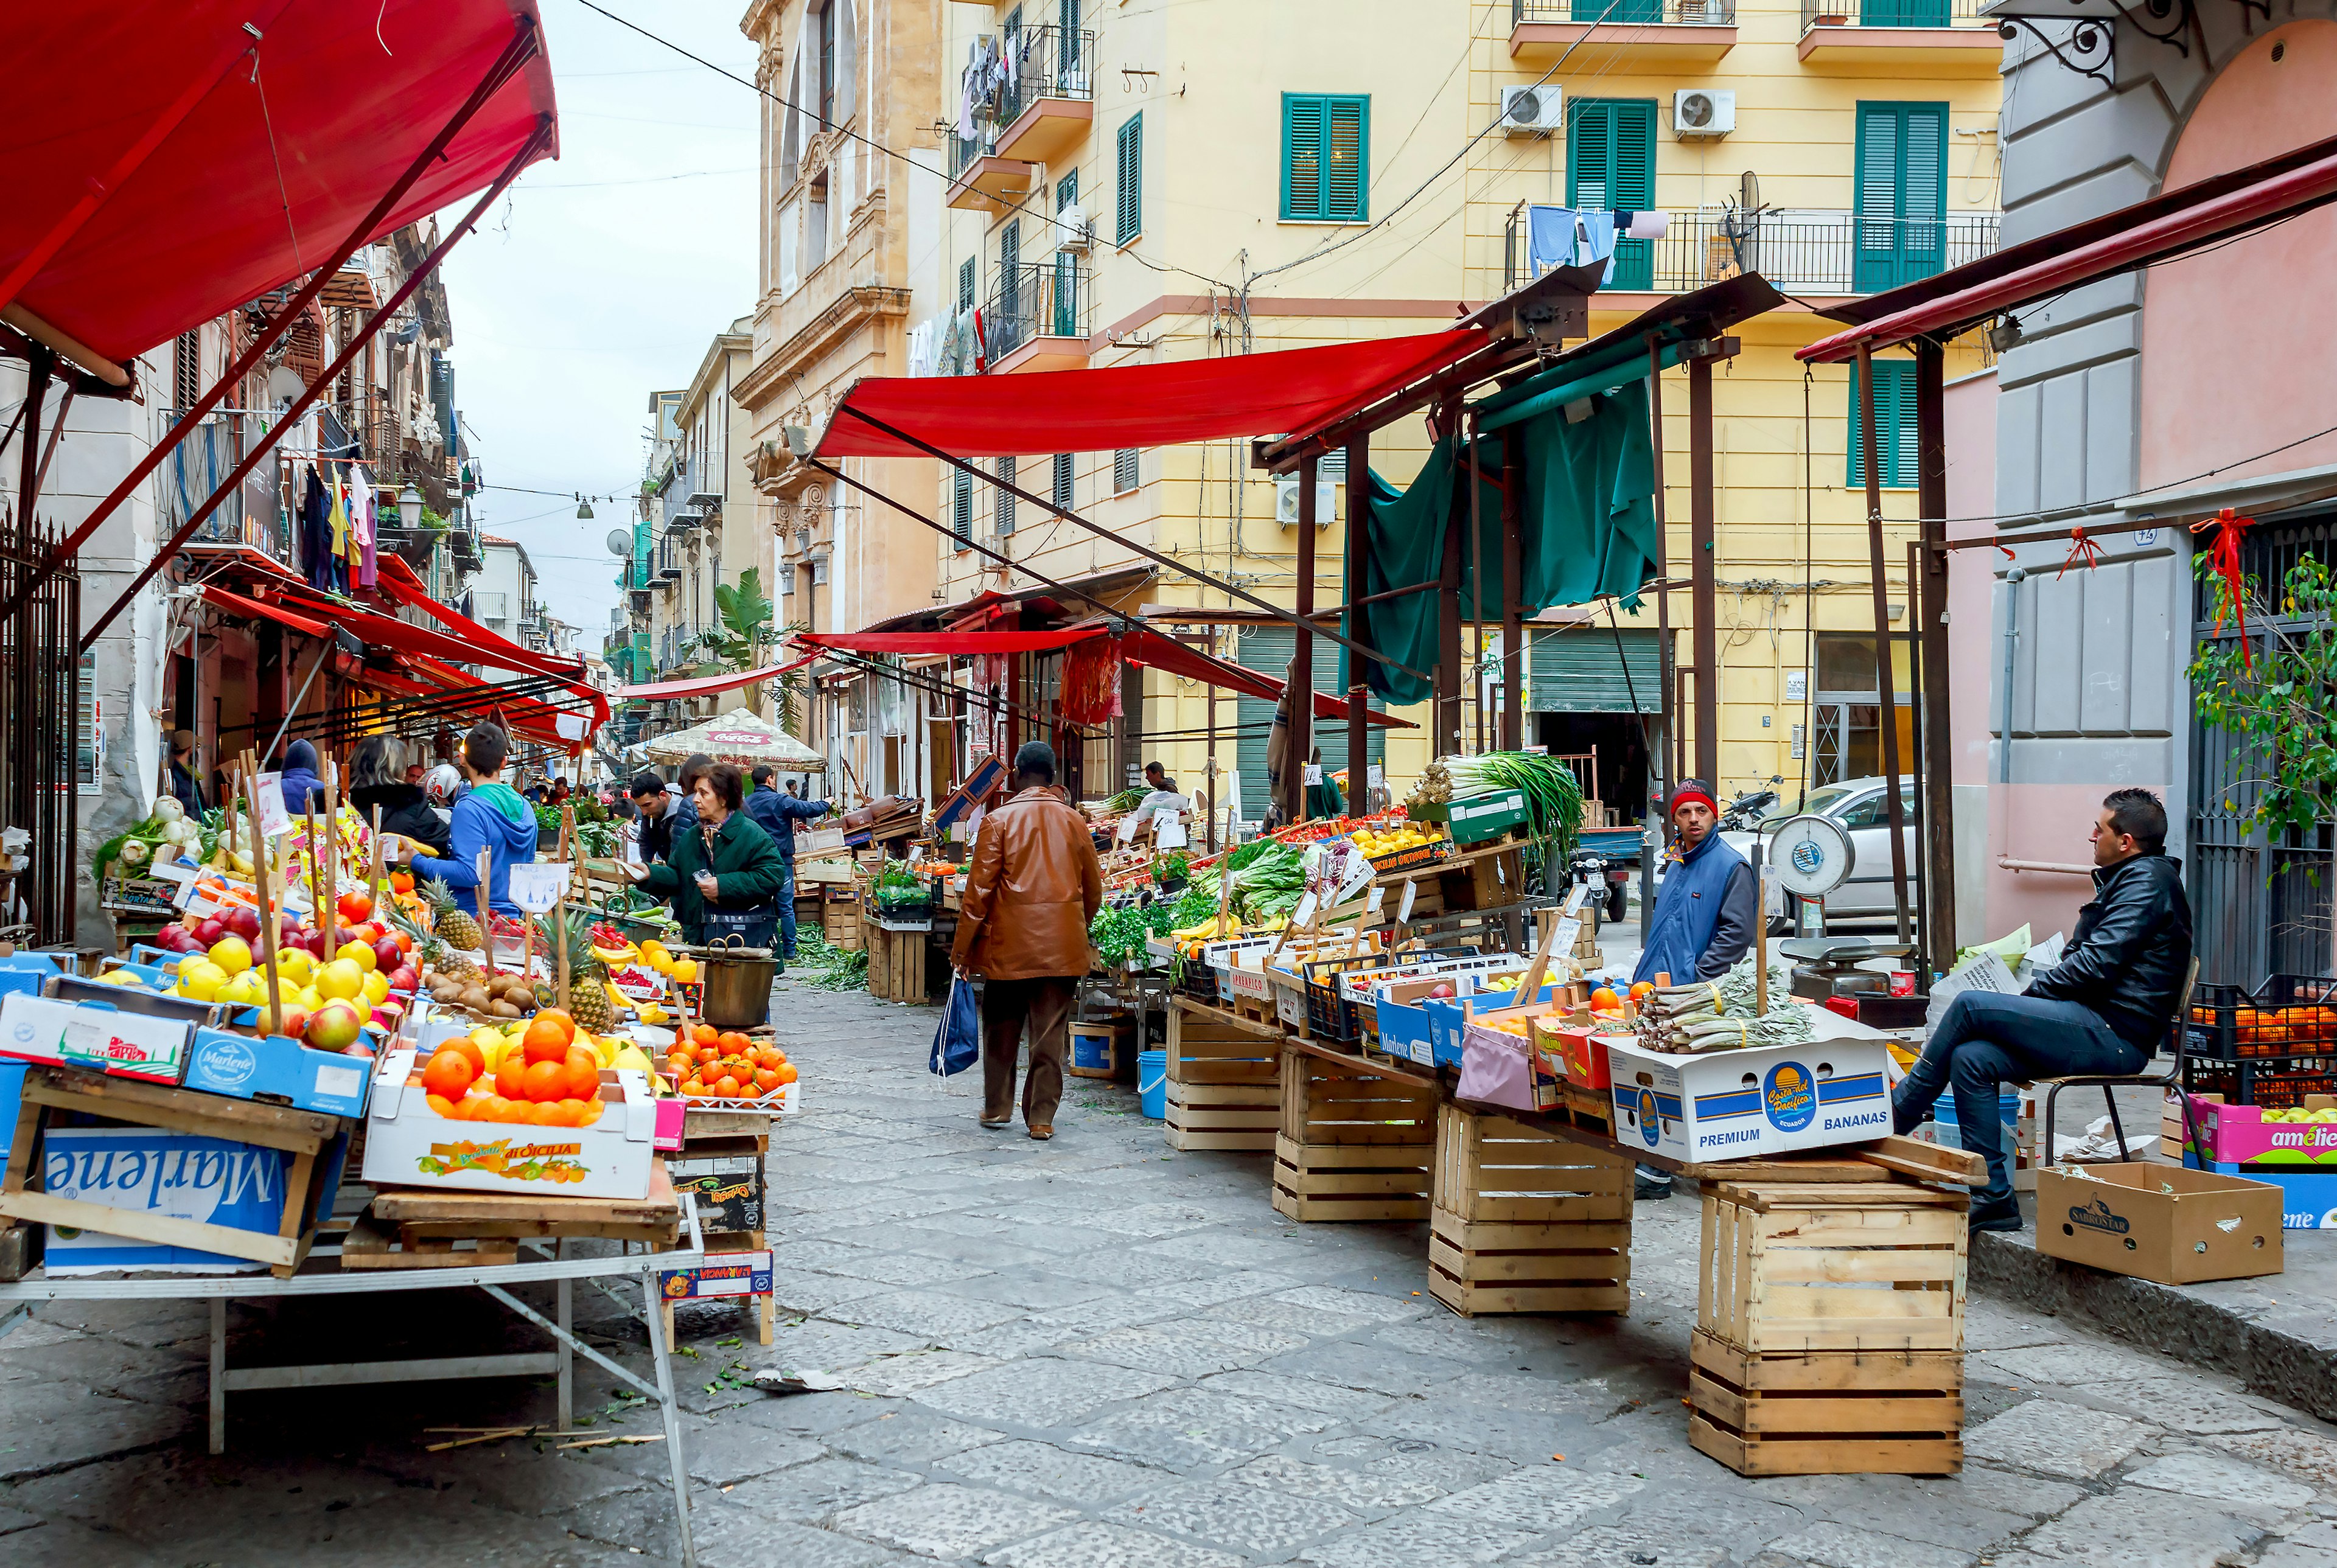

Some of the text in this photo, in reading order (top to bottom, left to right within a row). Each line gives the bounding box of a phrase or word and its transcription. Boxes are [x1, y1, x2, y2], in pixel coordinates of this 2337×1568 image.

[1373, 848, 1431, 871] SICILIA ORTAGGI
[1232, 974, 1262, 990] SPREAFICO
[1991, 980, 2001, 994] Rom
[1382, 1032, 1408, 1058] Marlene
[203, 1050, 252, 1070] Marlene
[1767, 1078, 1808, 1104] Costa del
[1779, 1117, 1806, 1127] ECUADOR
[1824, 1111, 1887, 1131] BANANAS
[1699, 1129, 1760, 1148] PREMIUM
[2271, 1125, 2337, 1147] amélie
[459, 1143, 571, 1166] Prodotti di SICILIA
[46, 1150, 276, 1210] Marlene
[711, 1186, 749, 1204] Ortaggi
[699, 1267, 751, 1280] L'ARANCIA
